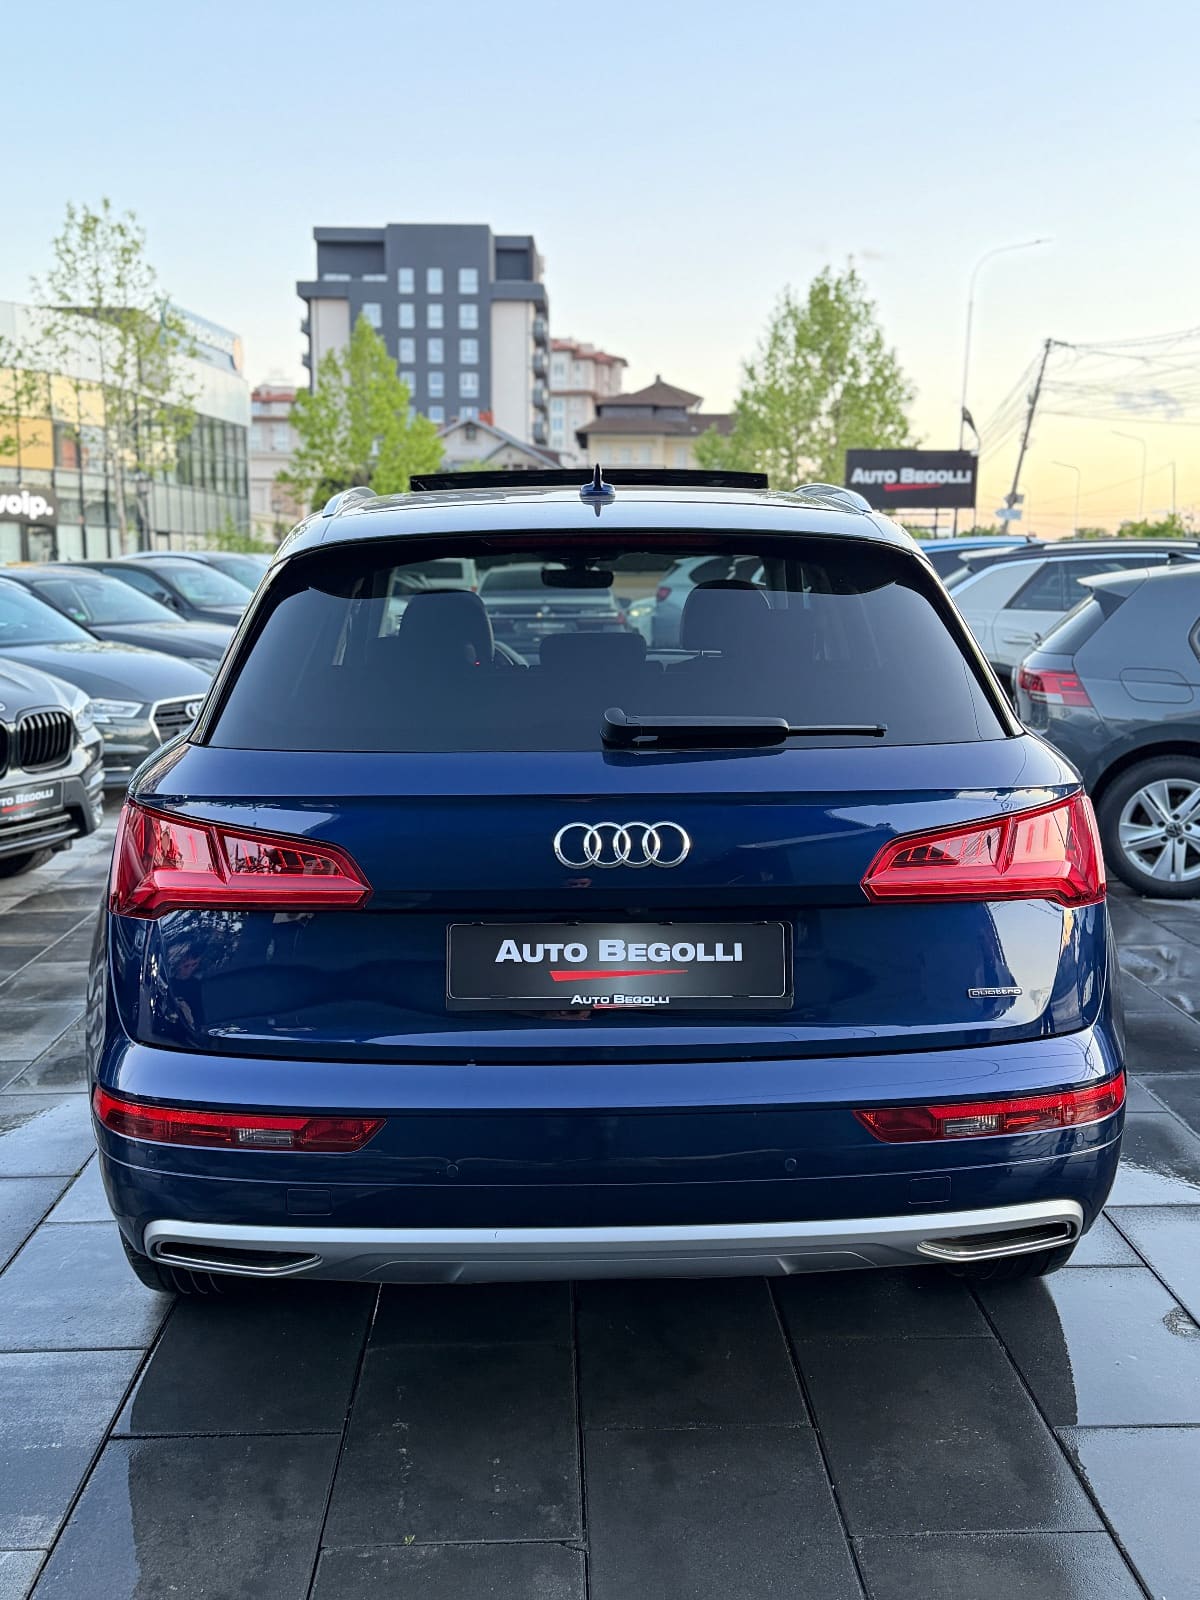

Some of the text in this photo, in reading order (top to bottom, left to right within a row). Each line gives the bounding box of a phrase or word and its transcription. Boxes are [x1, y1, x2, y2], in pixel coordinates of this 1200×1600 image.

[851, 467, 972, 484] AUTO BEGOLLI
[0, 797, 14, 807] TO
[495, 939, 743, 963] AUTO BEGOLLI
[570, 994, 670, 1005] AUTO BEGOLLI
